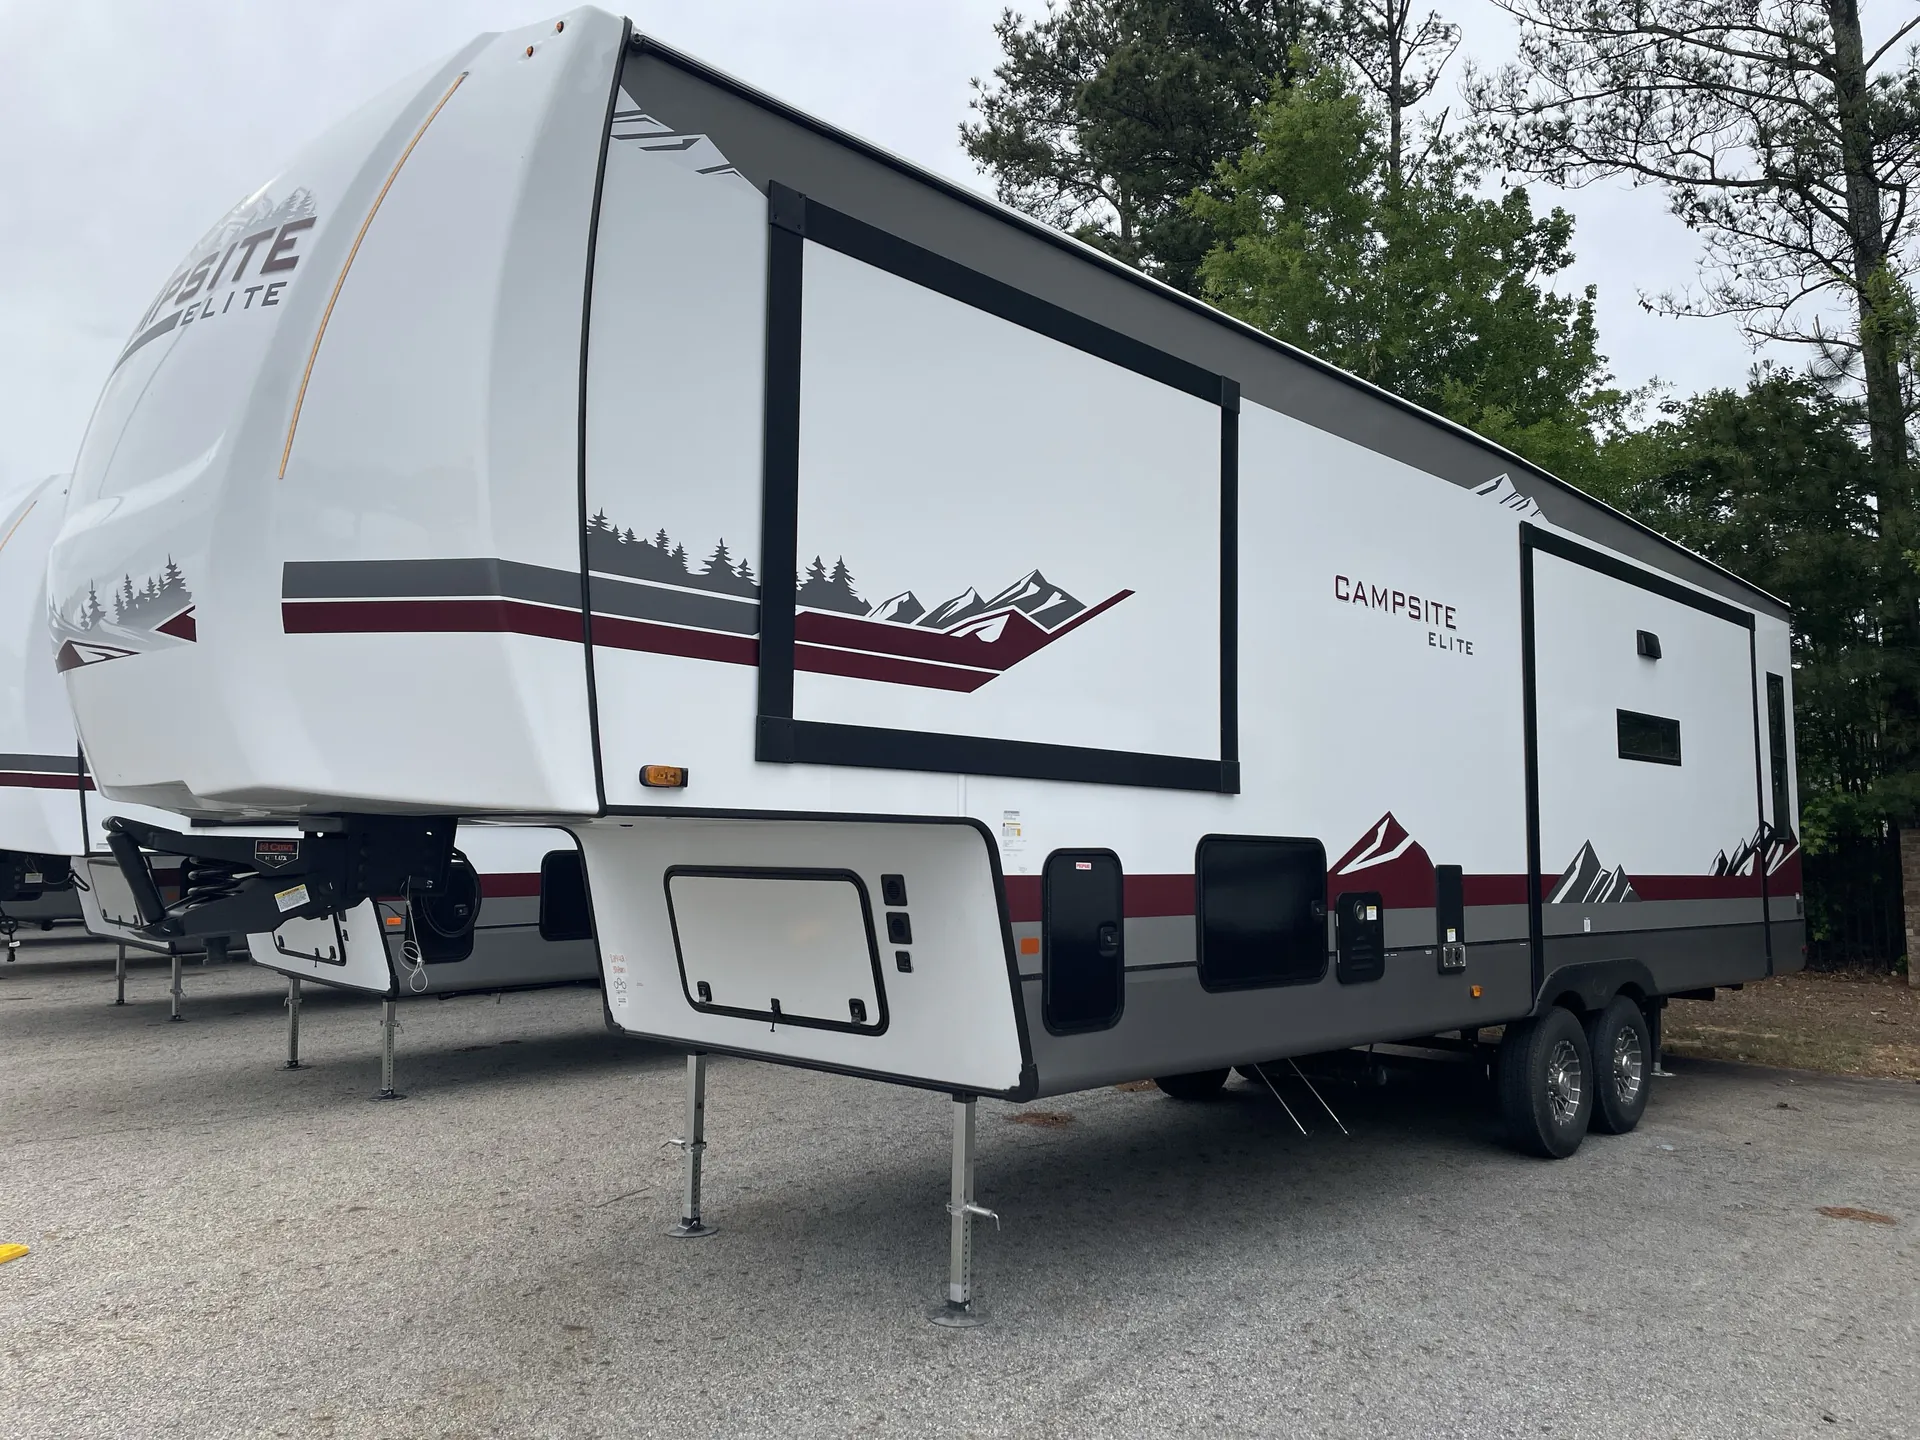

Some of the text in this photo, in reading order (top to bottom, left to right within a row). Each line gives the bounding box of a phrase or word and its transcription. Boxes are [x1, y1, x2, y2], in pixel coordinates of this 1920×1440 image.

[179, 280, 288, 327] ELITE
[1334, 574, 1457, 630] CAMPSITE
[1428, 631, 1474, 656] ELITE
